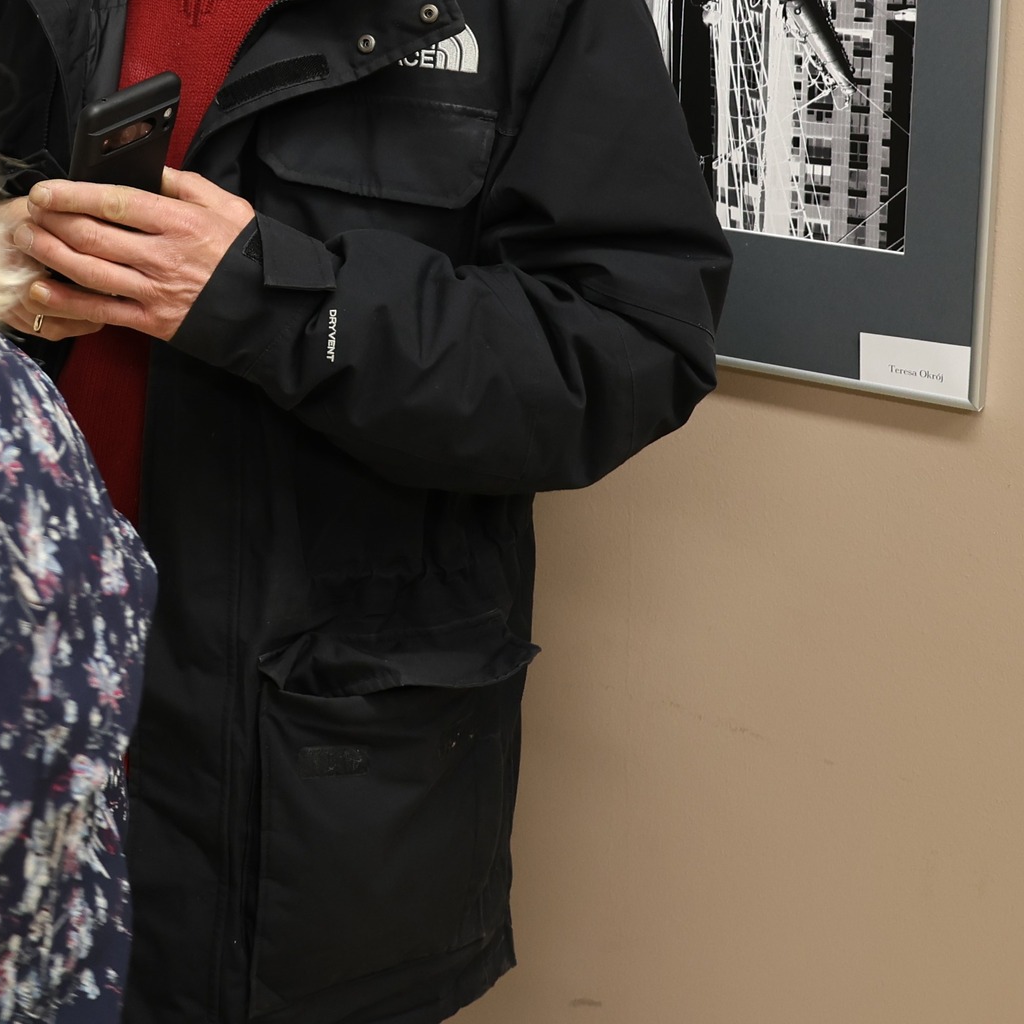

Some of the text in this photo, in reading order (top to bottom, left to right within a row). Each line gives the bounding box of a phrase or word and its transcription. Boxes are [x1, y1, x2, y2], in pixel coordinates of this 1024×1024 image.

[326, 309, 337, 363] DRYVENT
[888, 364, 944, 383] Teresa Okrój
